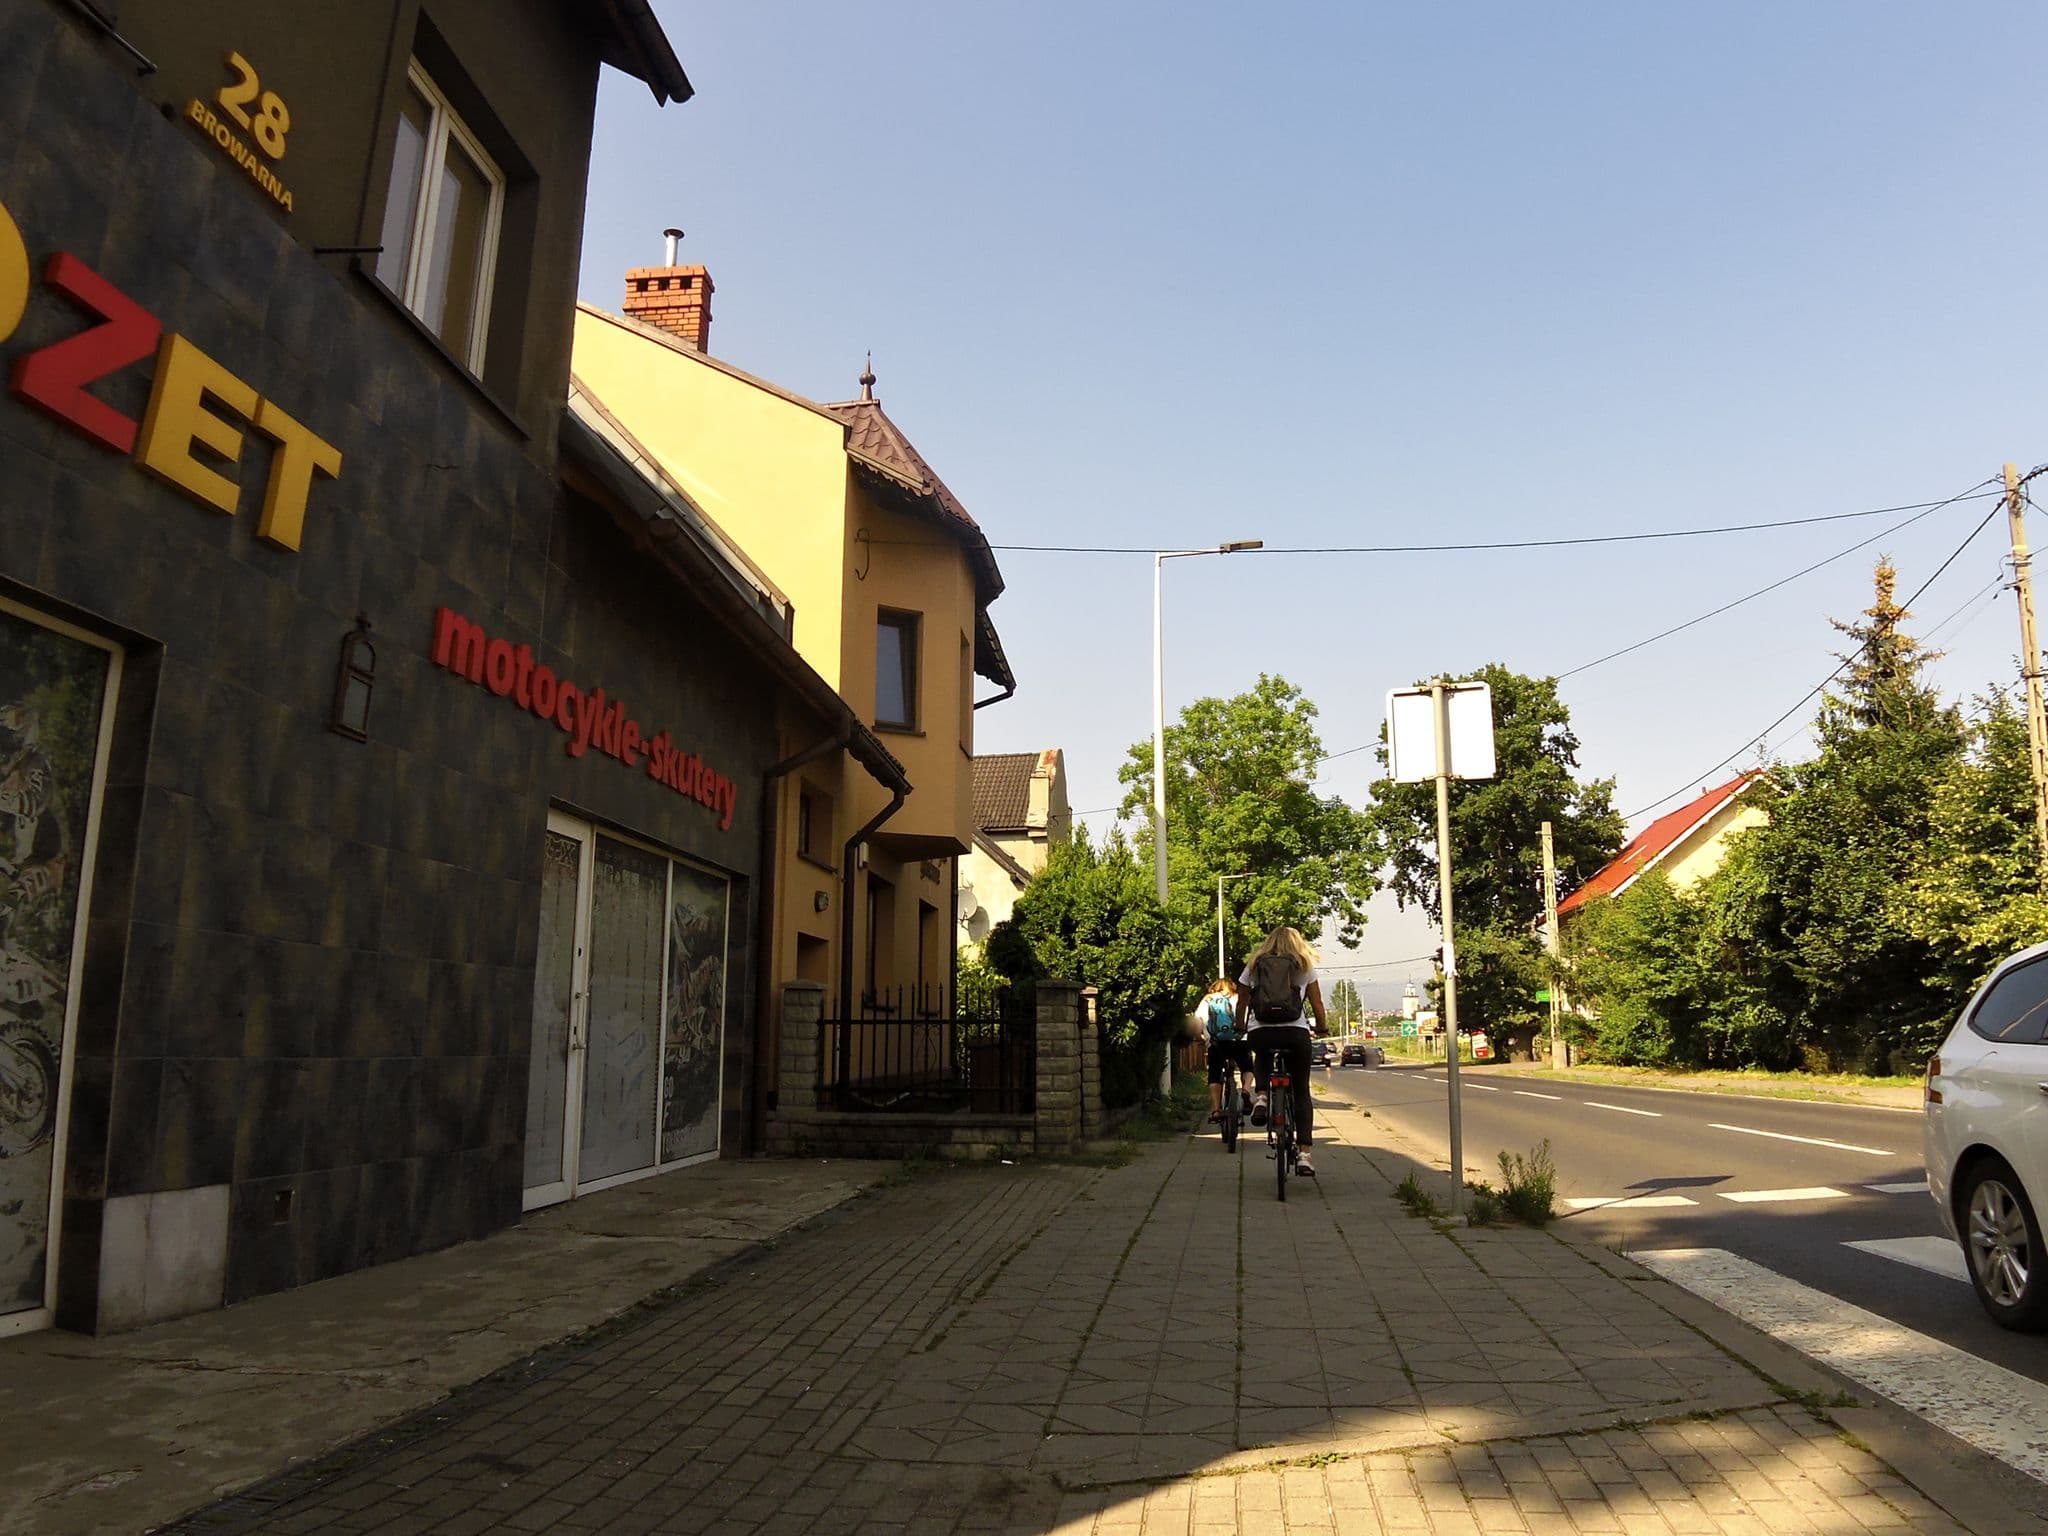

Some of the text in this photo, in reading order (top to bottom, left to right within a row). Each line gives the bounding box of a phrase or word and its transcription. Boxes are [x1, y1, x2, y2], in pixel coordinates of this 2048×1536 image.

[188, 98, 294, 212] BROWARNA
[218, 51, 290, 160] 28
[433, 607, 738, 831] motocykle-skutery
